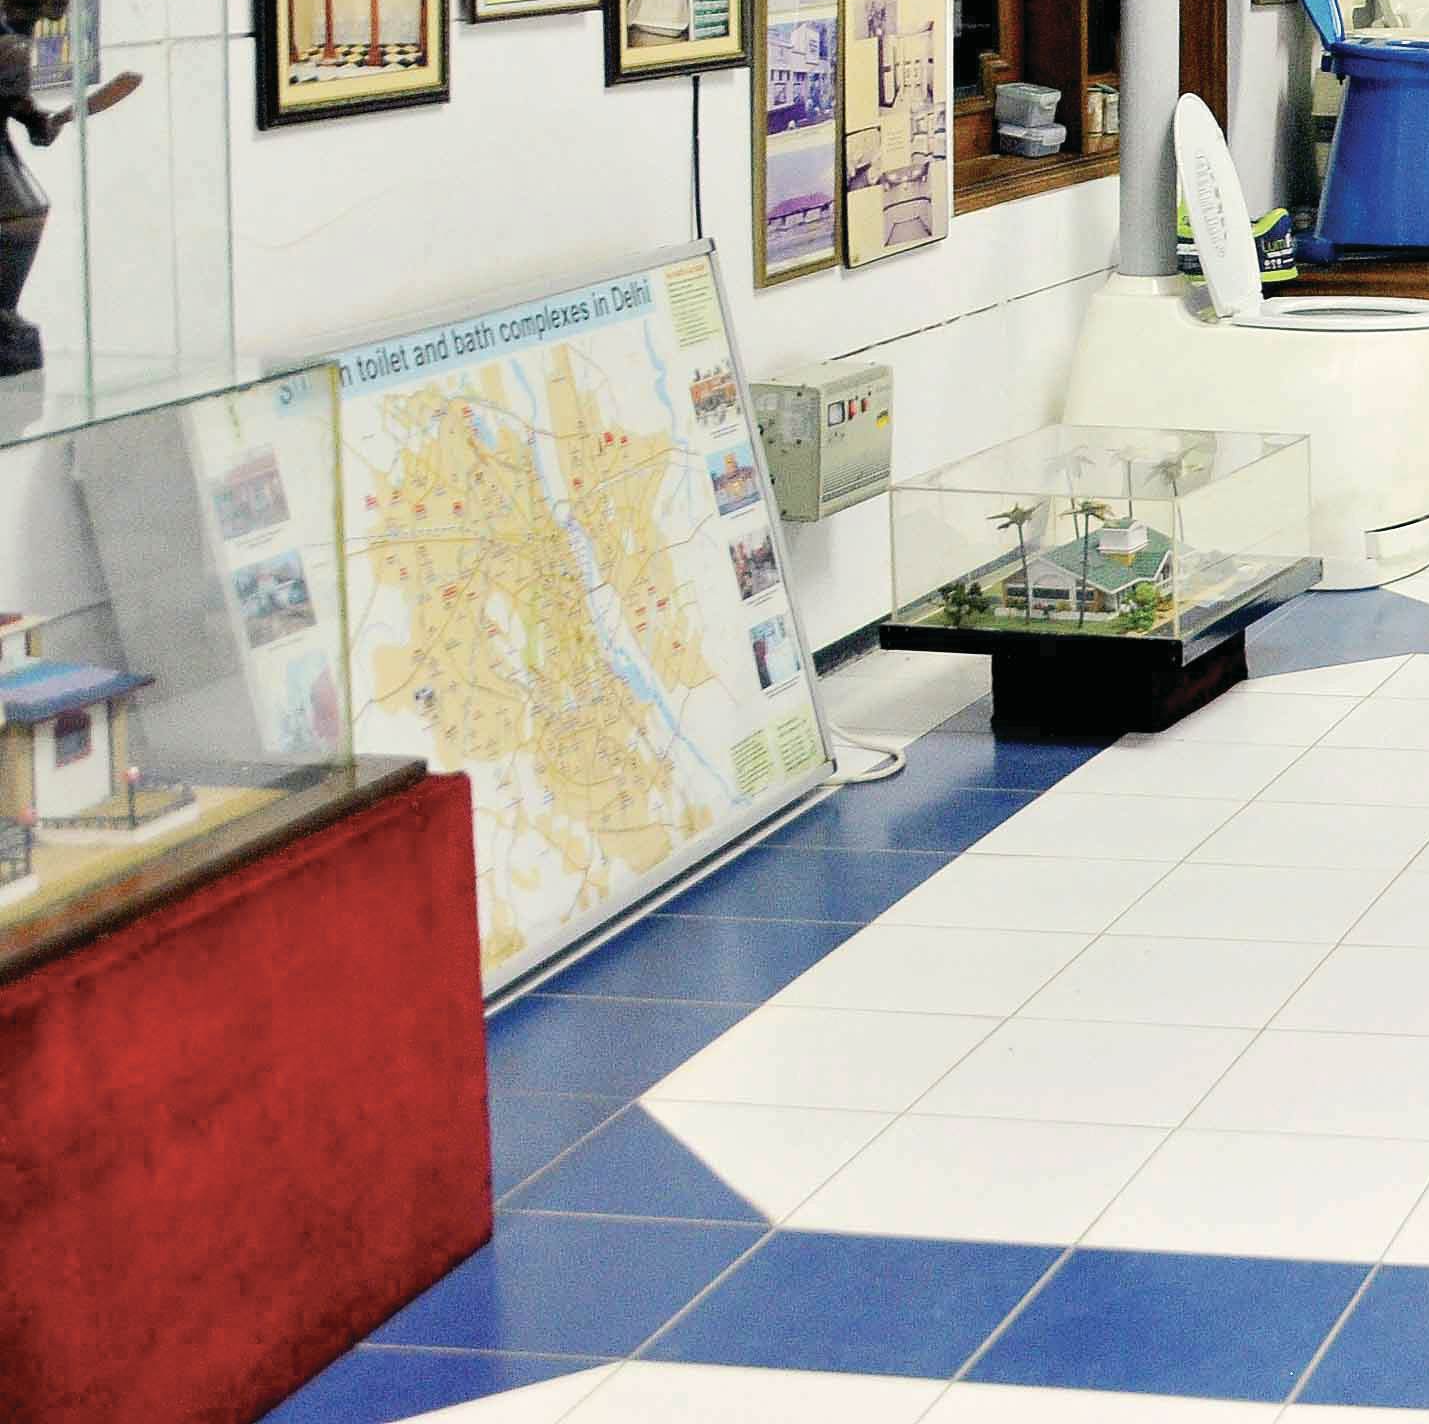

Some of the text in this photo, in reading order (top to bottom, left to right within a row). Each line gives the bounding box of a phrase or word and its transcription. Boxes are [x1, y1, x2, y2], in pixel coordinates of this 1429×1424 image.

[358, 345, 409, 383] toilet
[413, 334, 450, 368] and
[454, 322, 496, 357] bath
[499, 297, 591, 346] complexes
[592, 292, 610, 319] in
[611, 278, 653, 313] Delhi
